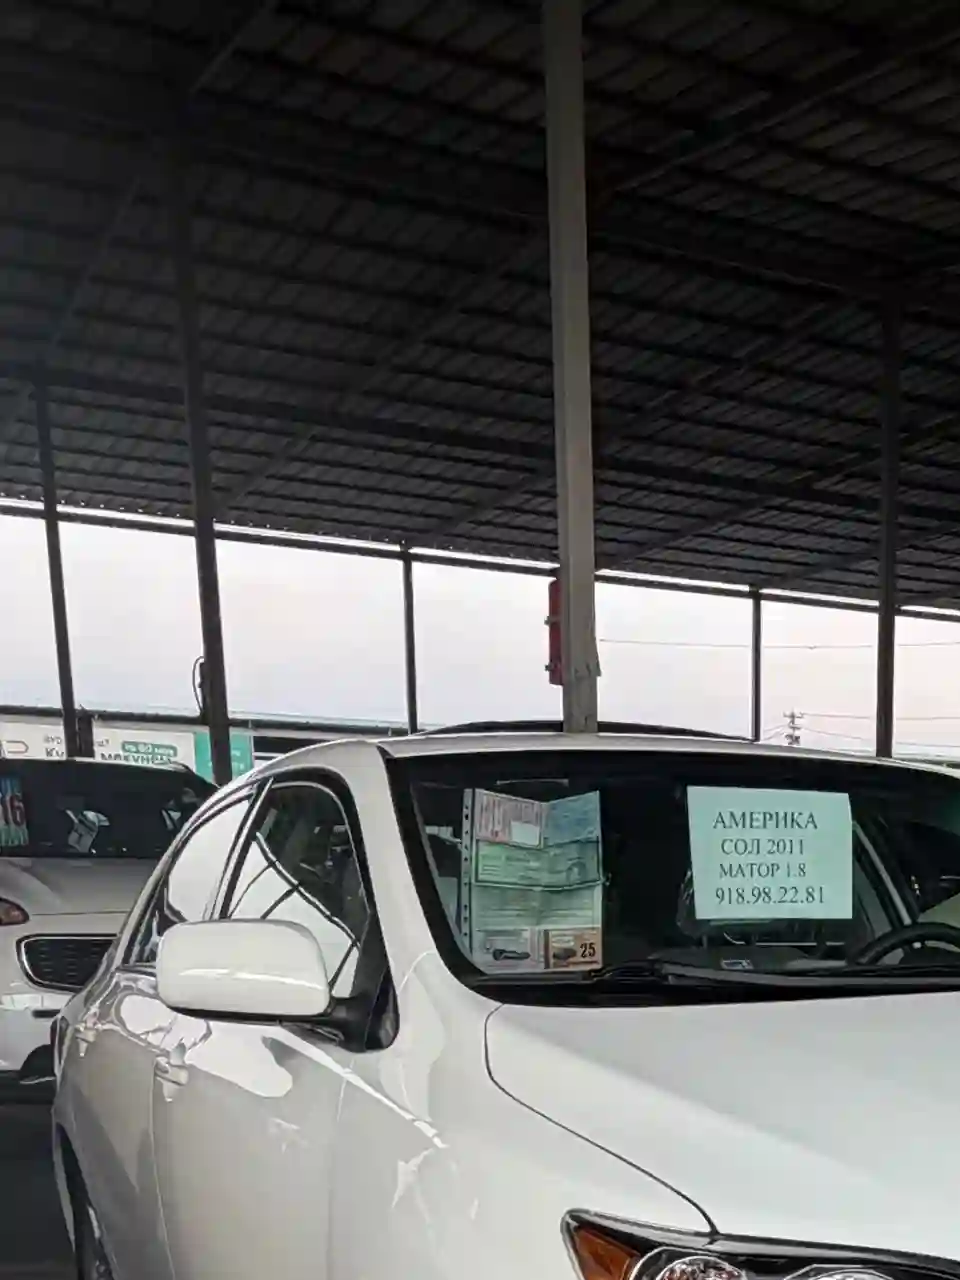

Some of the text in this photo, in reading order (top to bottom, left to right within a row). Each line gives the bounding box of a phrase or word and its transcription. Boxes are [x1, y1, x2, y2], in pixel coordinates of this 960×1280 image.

[713, 811, 818, 829] АМЕРИКА
[721, 838, 805, 856] СОЛ 2011
[719, 862, 806, 879] МАТОР 1.8
[715, 886, 824, 905] 918.98.22.81
[580, 942, 597, 959] 25
